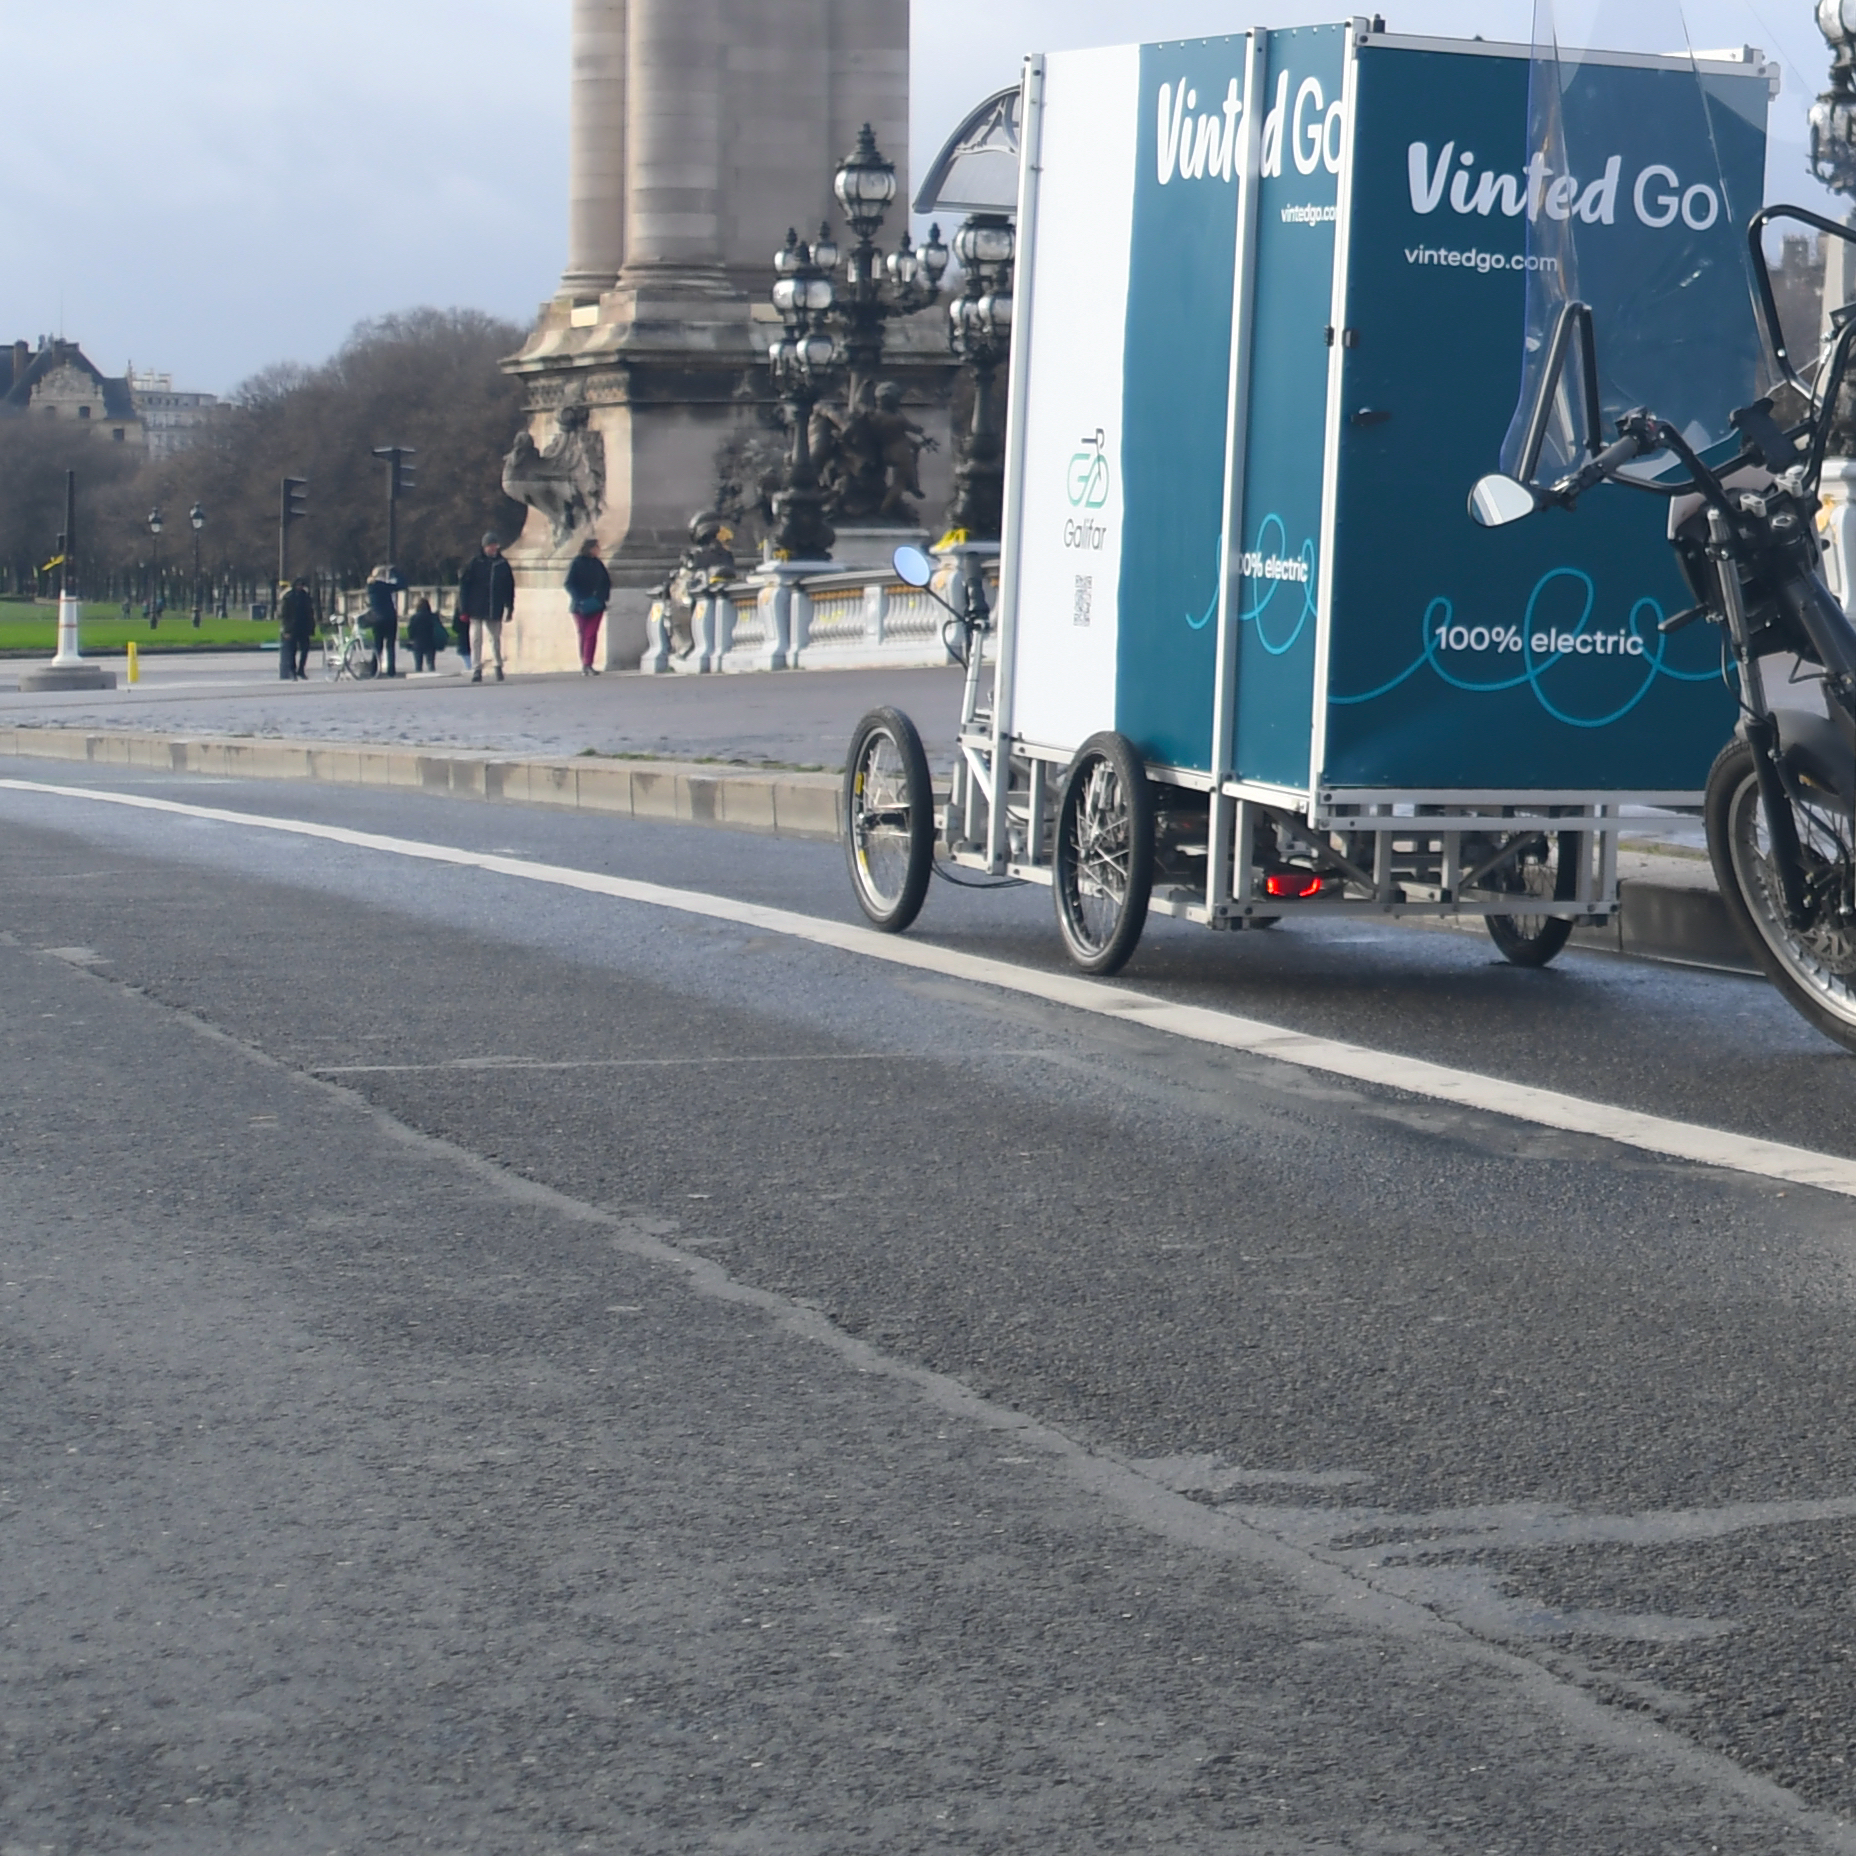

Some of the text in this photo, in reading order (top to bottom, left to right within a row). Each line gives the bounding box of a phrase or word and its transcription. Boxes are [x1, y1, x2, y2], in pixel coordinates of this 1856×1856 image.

[1292, 77, 1344, 175] Go
[1408, 141, 1718, 231] Vinted Go
[1281, 203, 1336, 227] vintedgo.co
[1404, 245, 1558, 273] vintedgo.com
[1063, 517, 1107, 551] Galifar
[1265, 554, 1308, 582] electric
[1435, 625, 1644, 655] 100% electric
